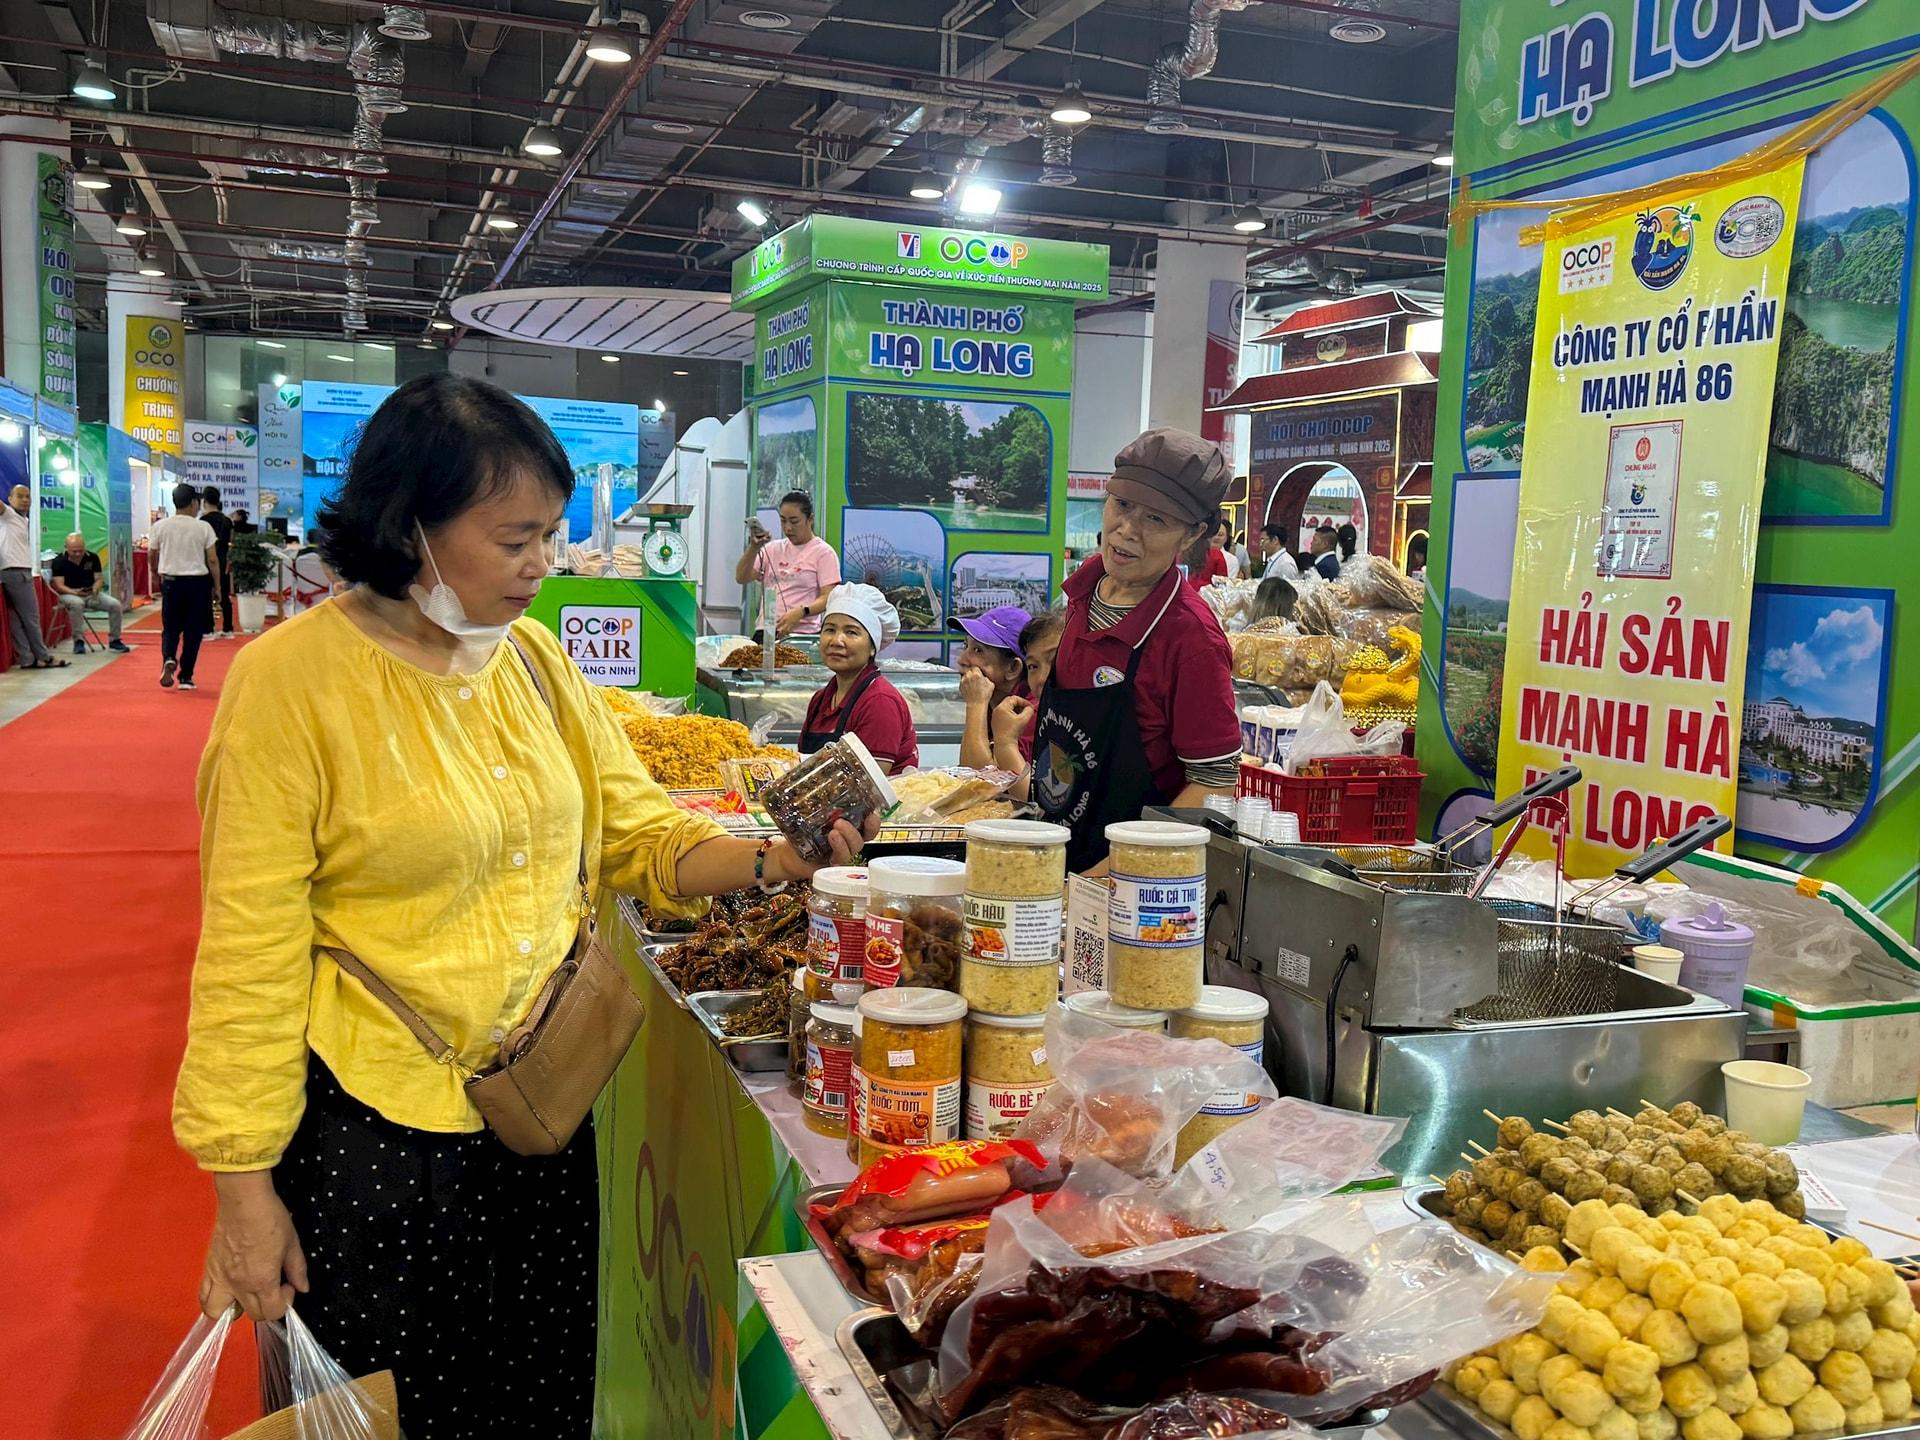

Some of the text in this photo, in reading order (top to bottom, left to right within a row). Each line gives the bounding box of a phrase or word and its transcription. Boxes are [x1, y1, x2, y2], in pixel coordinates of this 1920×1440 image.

[1519, 0, 1866, 125] HẠ LON
[1563, 241, 1612, 270] OCOP
[816, 259, 1102, 292] CHƯƠNG TRÌNH CẤP QUỐC GIA VỀ XÚC TIẾN THƯƠNG MẠI NĂM 2025
[768, 297, 810, 339] THÀNH PHỐ
[883, 299, 1024, 332] THÀNH PHỐ
[1554, 290, 1777, 367] CÔNG TY CỔ PHẦN
[764, 335, 812, 386] HẠ LONG
[870, 333, 1033, 377] HẠ LONG
[1581, 360, 1733, 419] MẠNH HÀ 86
[142, 401, 174, 418] TRÌNH
[1270, 421, 1294, 440] HỘI
[1332, 415, 1373, 436] OCOP
[1375, 439, 1390, 453] 2025
[566, 617, 633, 635] OCOP
[1540, 591, 1730, 683] HẢI SẢN
[566, 638, 632, 659] FAIR
[610, 666, 636, 675] NINH
[1073, 728, 1092, 751] HÀ
[1084, 751, 1098, 769] 86
[1520, 687, 1731, 780] MẠNH HÀ
[1139, 886, 1197, 904] RUỐC CÁ THU
[877, 921, 892, 934] ME
[897, 1099, 920, 1113] TÔM
[989, 1091, 1015, 1108] RUỐC
